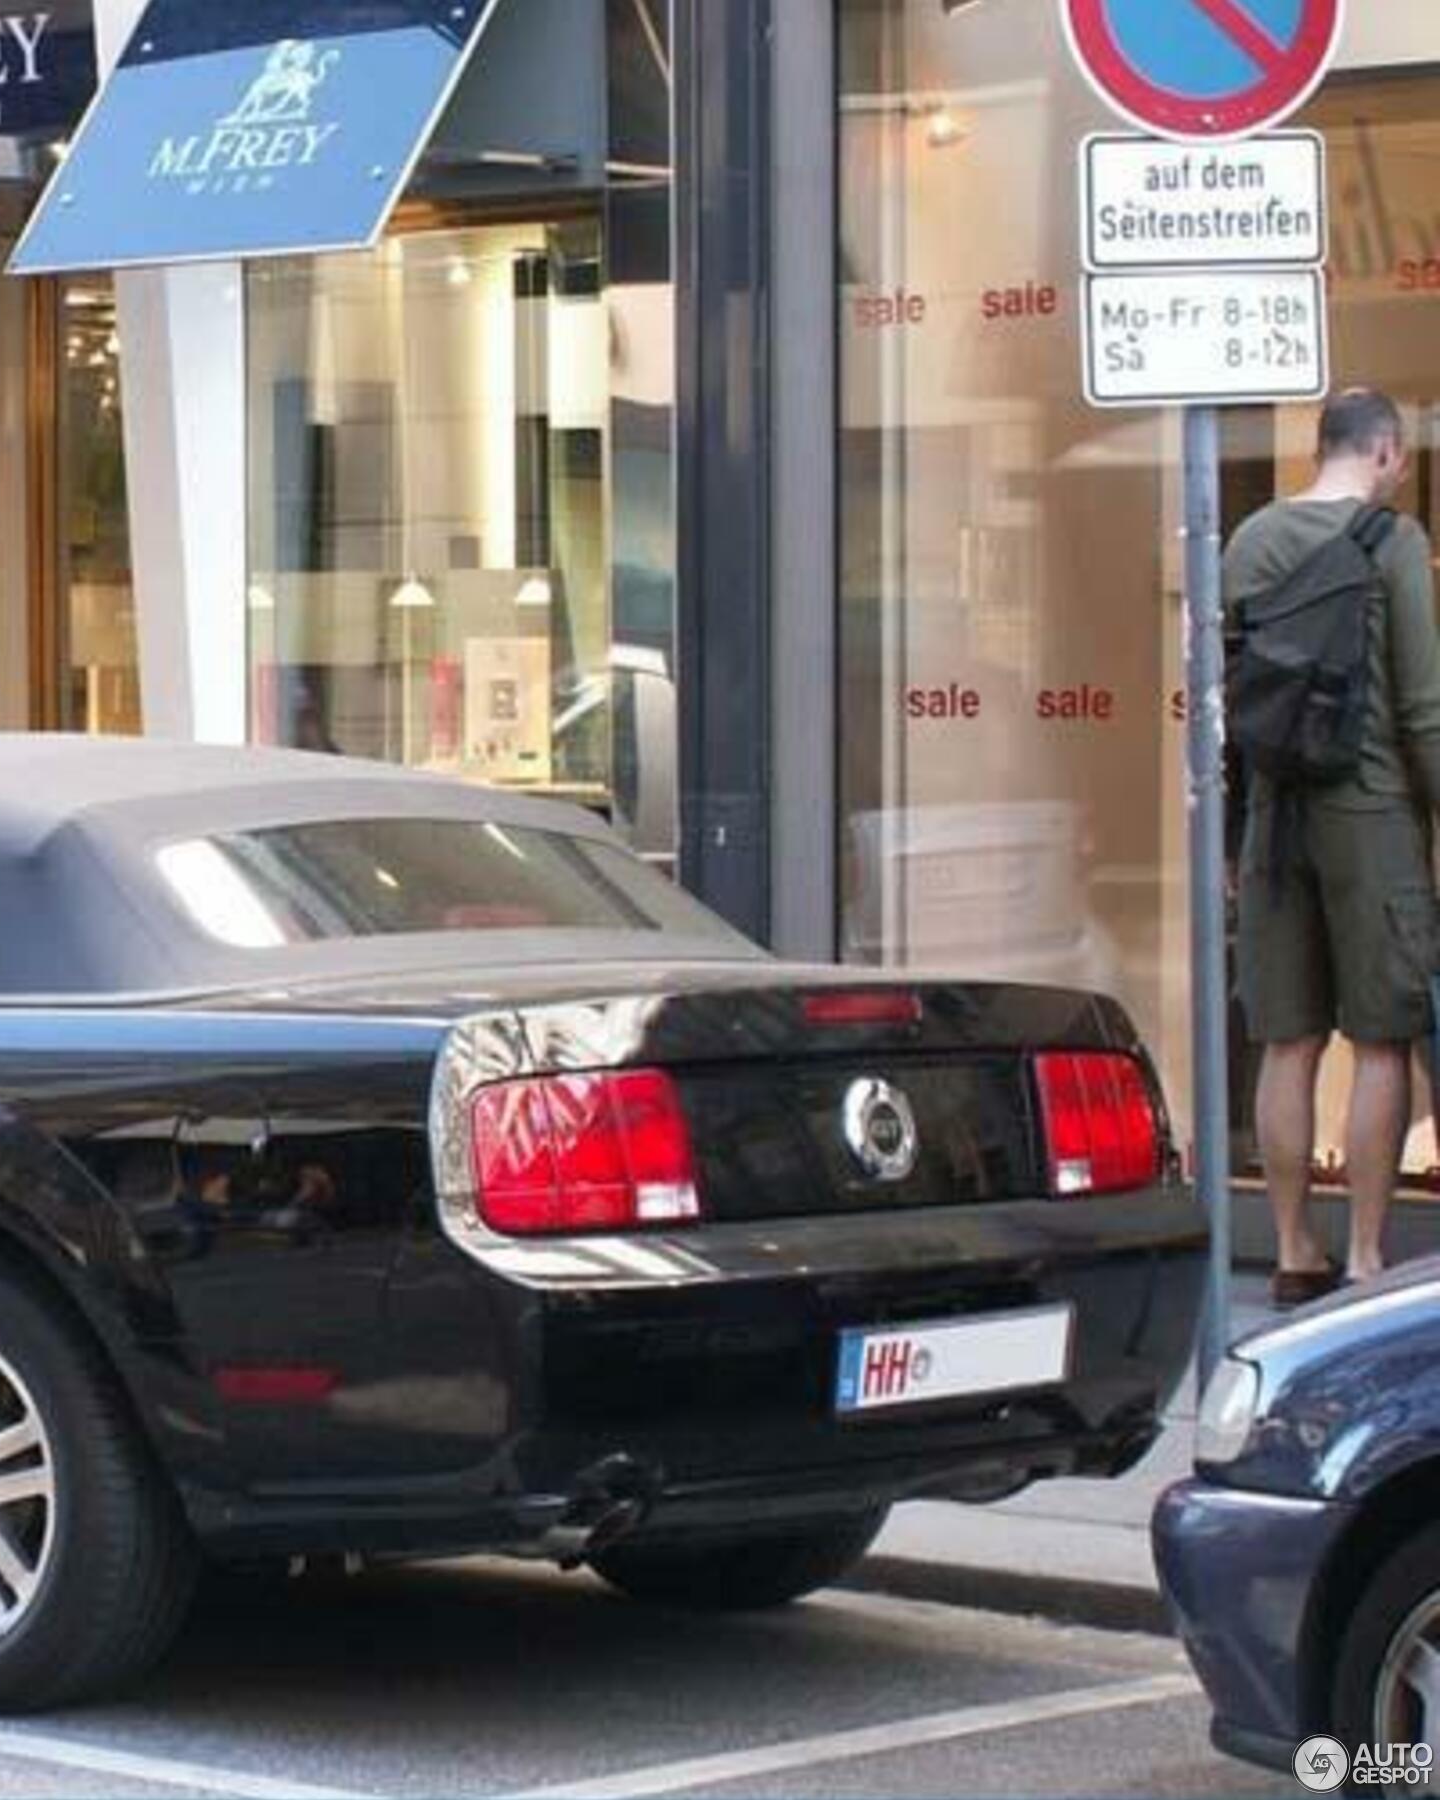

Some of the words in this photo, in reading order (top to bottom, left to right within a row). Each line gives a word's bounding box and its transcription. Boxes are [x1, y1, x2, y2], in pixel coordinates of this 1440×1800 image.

[1145, 156, 1192, 191] auf
[1201, 156, 1266, 190] dem
[1100, 198, 1311, 241] Seitenstreifen
[981, 281, 1056, 319] sale
[907, 682, 980, 718] sale
[1036, 683, 1113, 720] sale
[863, 1340, 911, 1398] HH
